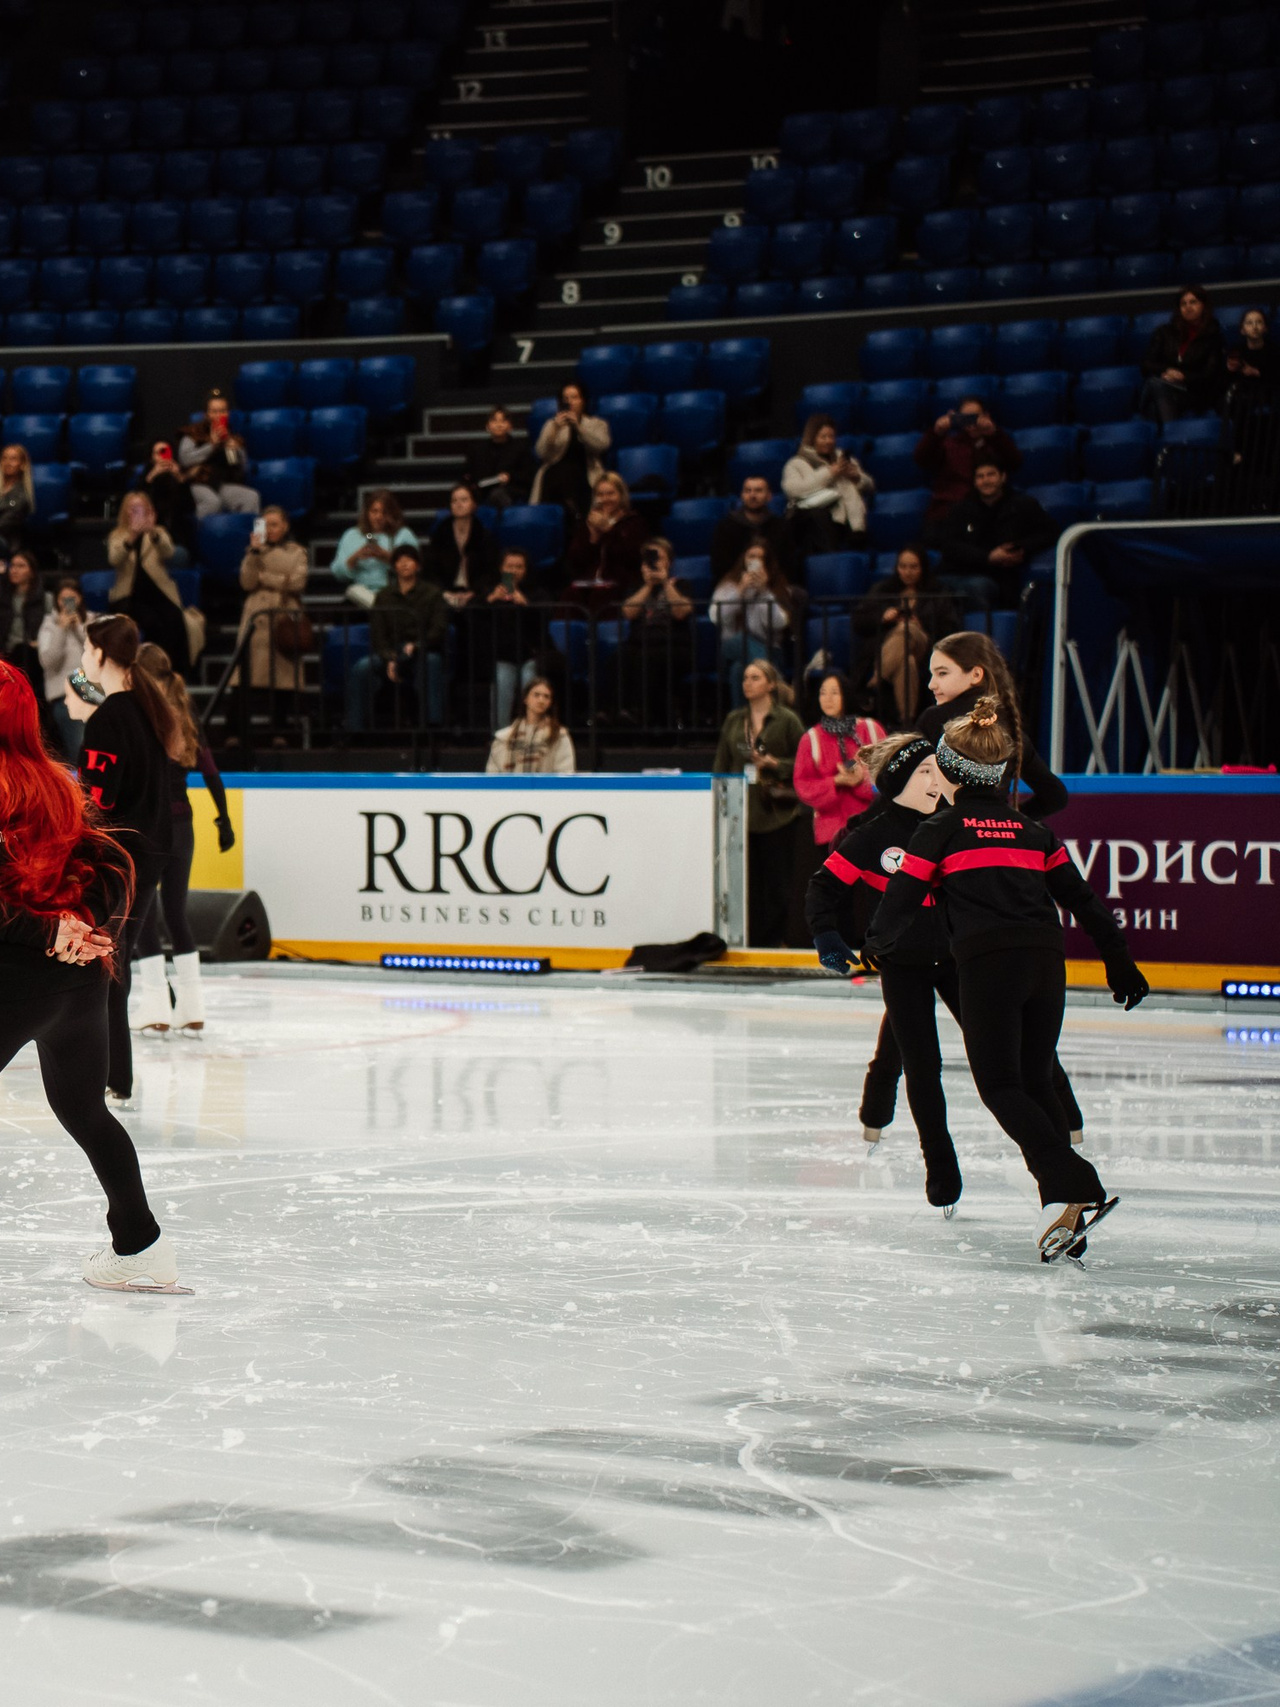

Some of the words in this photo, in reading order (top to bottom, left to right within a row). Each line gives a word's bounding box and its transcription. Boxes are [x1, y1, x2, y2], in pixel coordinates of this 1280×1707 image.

[457, 80, 483, 101] 12
[644, 165, 673, 189] 10
[603, 222, 623, 245] 9
[561, 280, 581, 305] 8
[516, 339, 535, 364] 7
[962, 817, 1024, 830] Malinin
[976, 829, 1016, 840] team
[358, 811, 610, 897] RRCC
[360, 905, 511, 925] BUSINESS
[528, 909, 607, 928] CLUB
